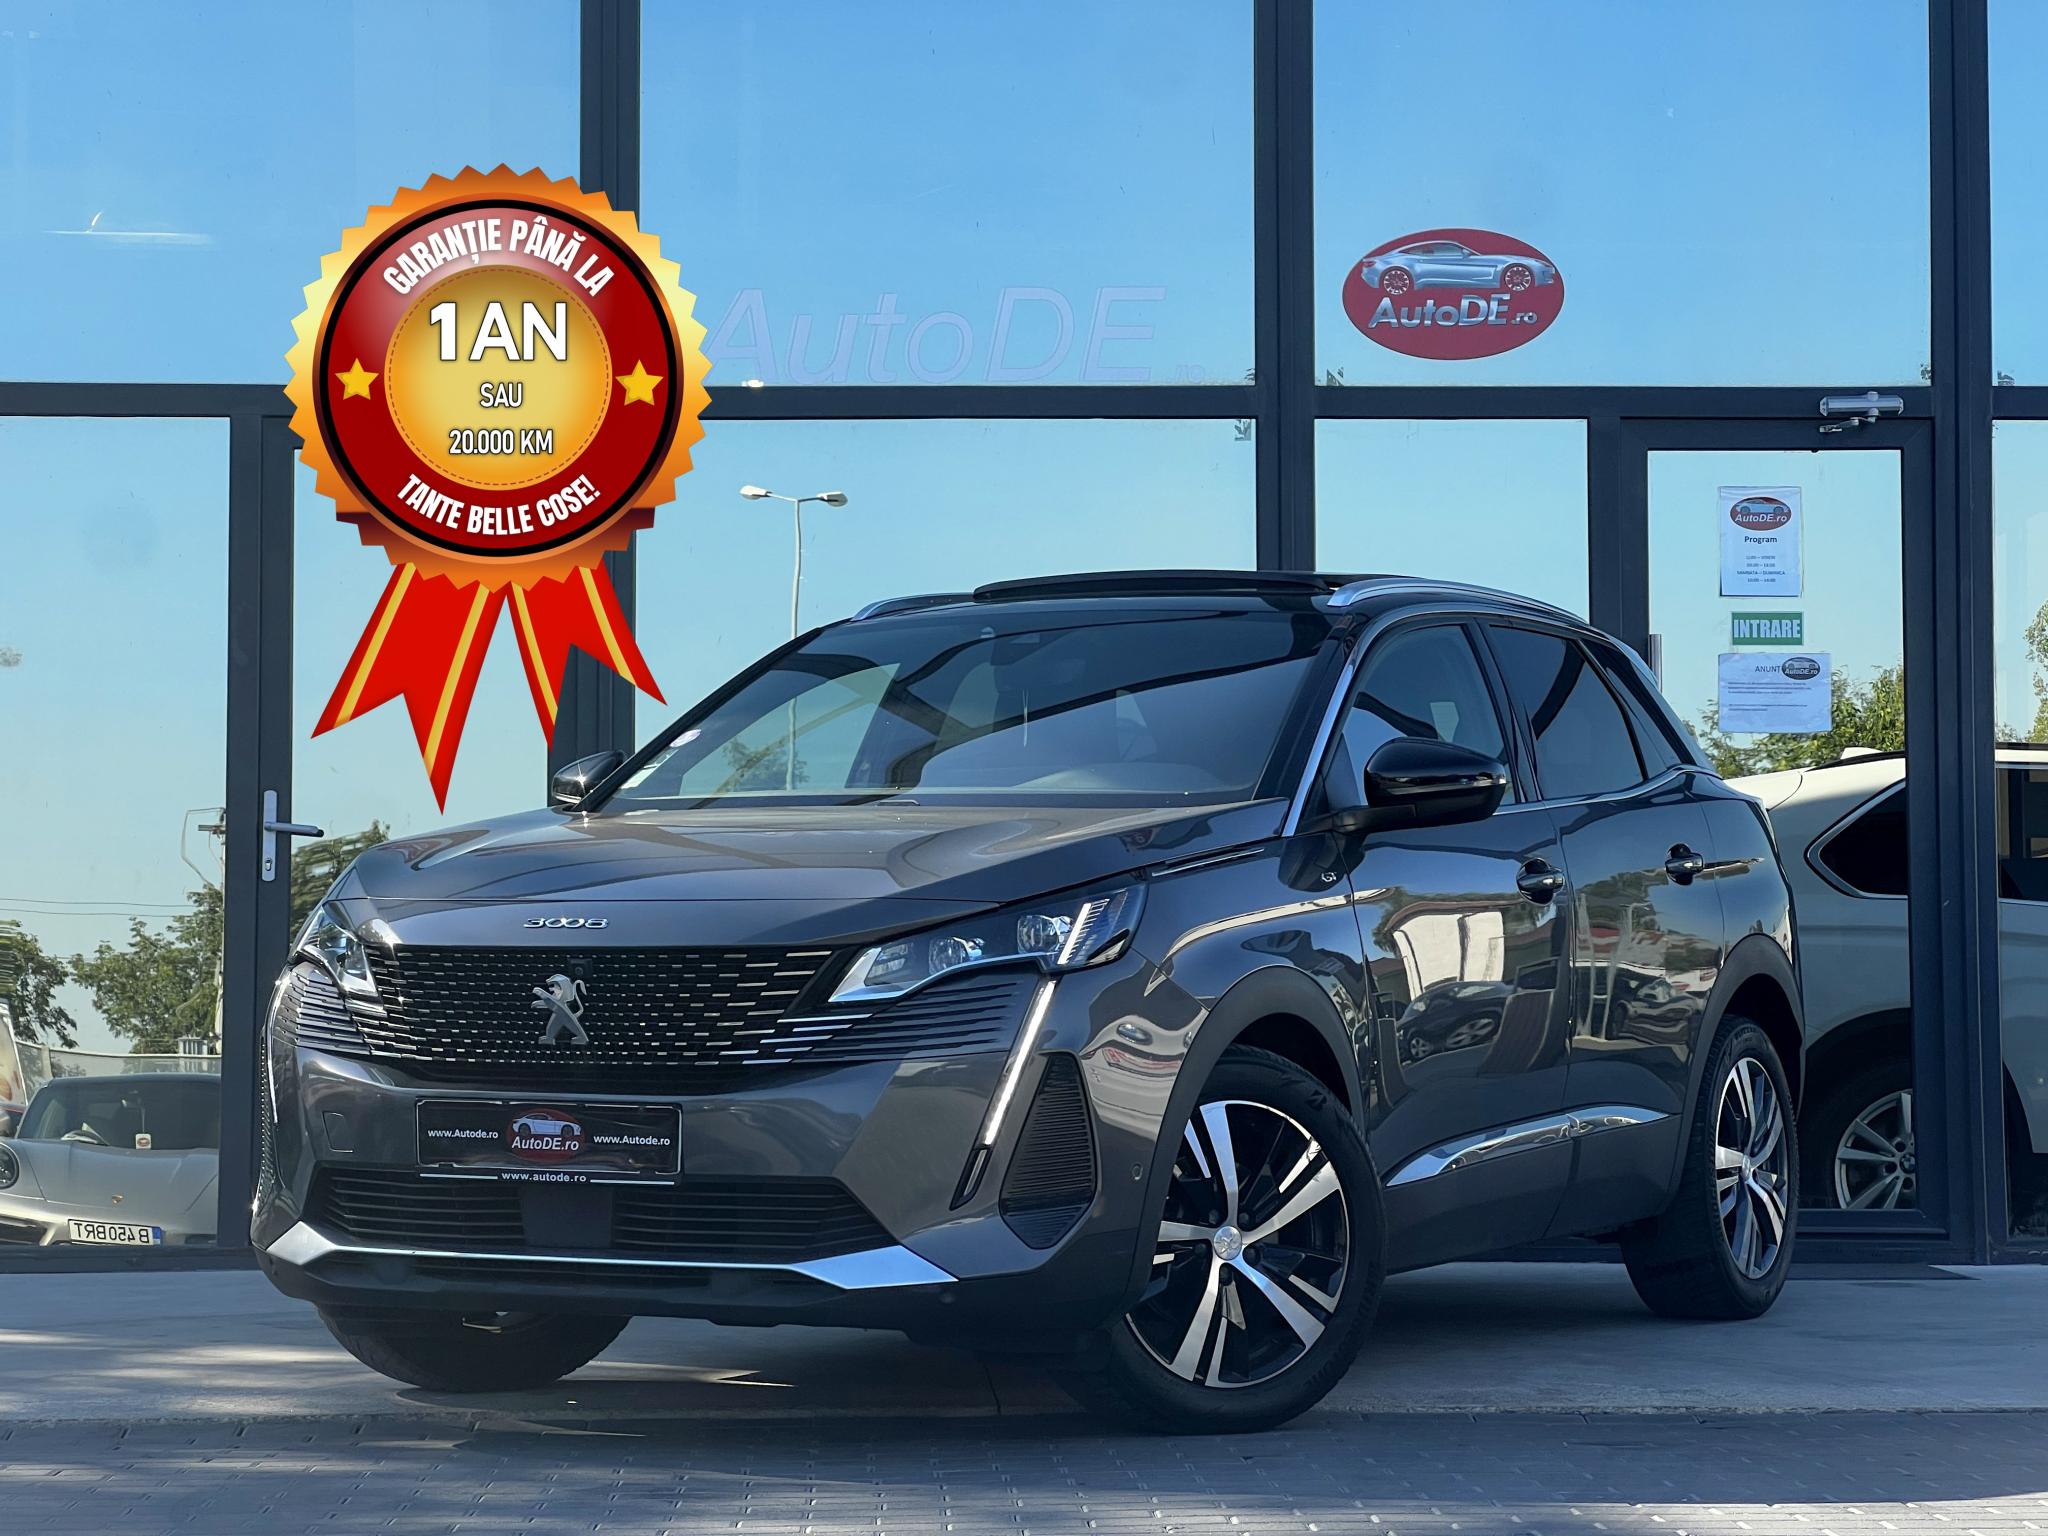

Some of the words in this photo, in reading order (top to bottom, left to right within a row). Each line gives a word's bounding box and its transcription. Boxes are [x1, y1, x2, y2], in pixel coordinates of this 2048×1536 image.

[1744, 535, 1778, 544] Program
[1733, 619, 1801, 638] INTRARE
[523, 917, 608, 929] 3008
[511, 1136, 580, 1152] AutoDE.ro
[501, 1171, 587, 1183] www.autode.ro
